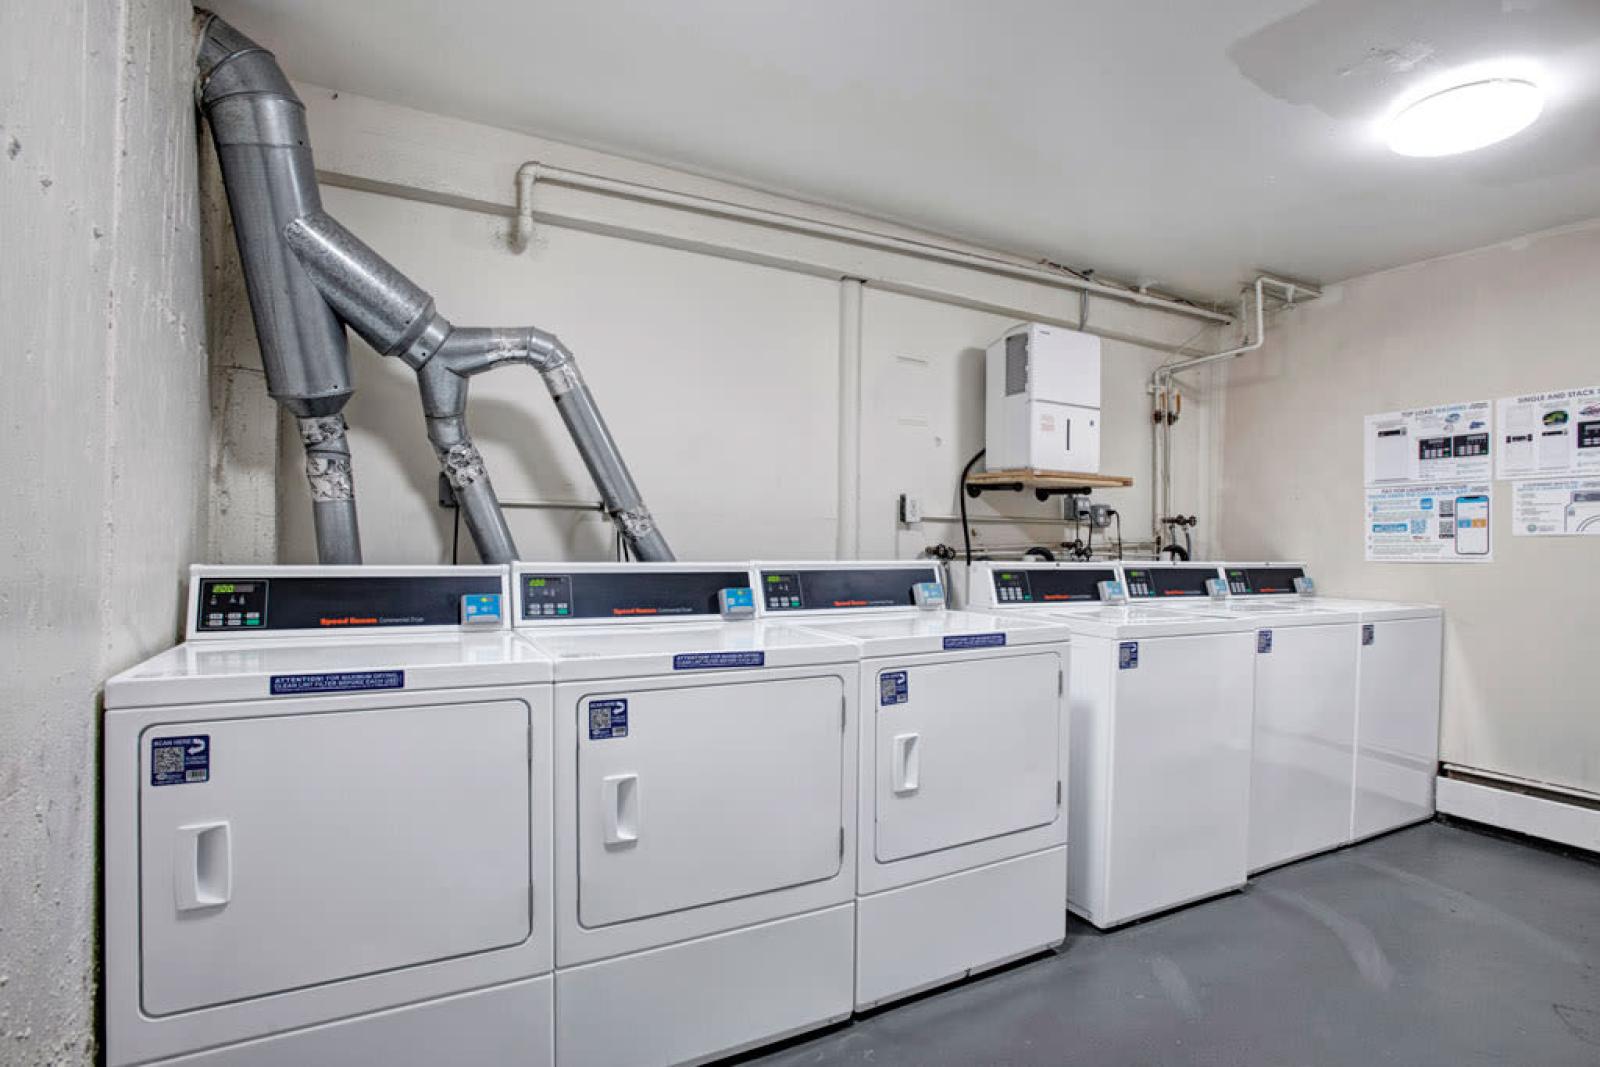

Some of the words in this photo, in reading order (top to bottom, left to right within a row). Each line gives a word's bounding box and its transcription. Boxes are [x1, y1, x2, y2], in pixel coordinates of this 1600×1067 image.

[1517, 394, 1545, 403] SINGLE
[1547, 391, 1566, 399] AND
[1568, 389, 1595, 398] STACK
